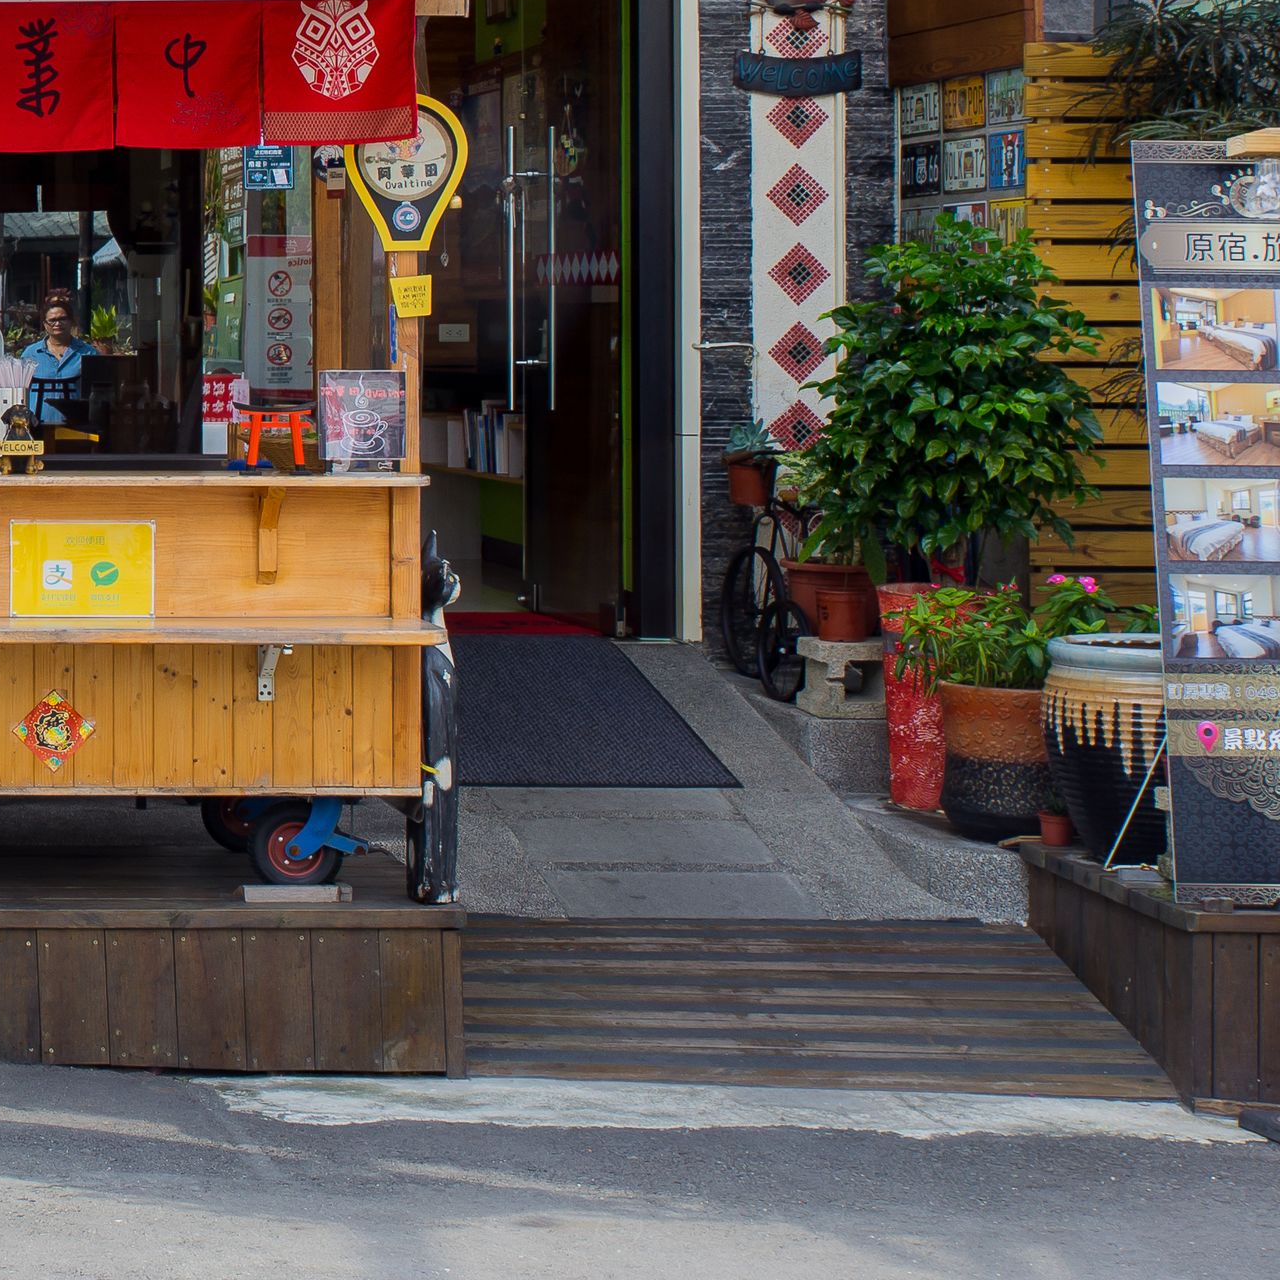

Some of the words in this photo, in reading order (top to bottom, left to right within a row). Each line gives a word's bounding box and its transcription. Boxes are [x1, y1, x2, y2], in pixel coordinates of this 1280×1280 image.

[377, 163, 439, 181] 阿華田
[385, 179, 433, 190] Ovaltine
